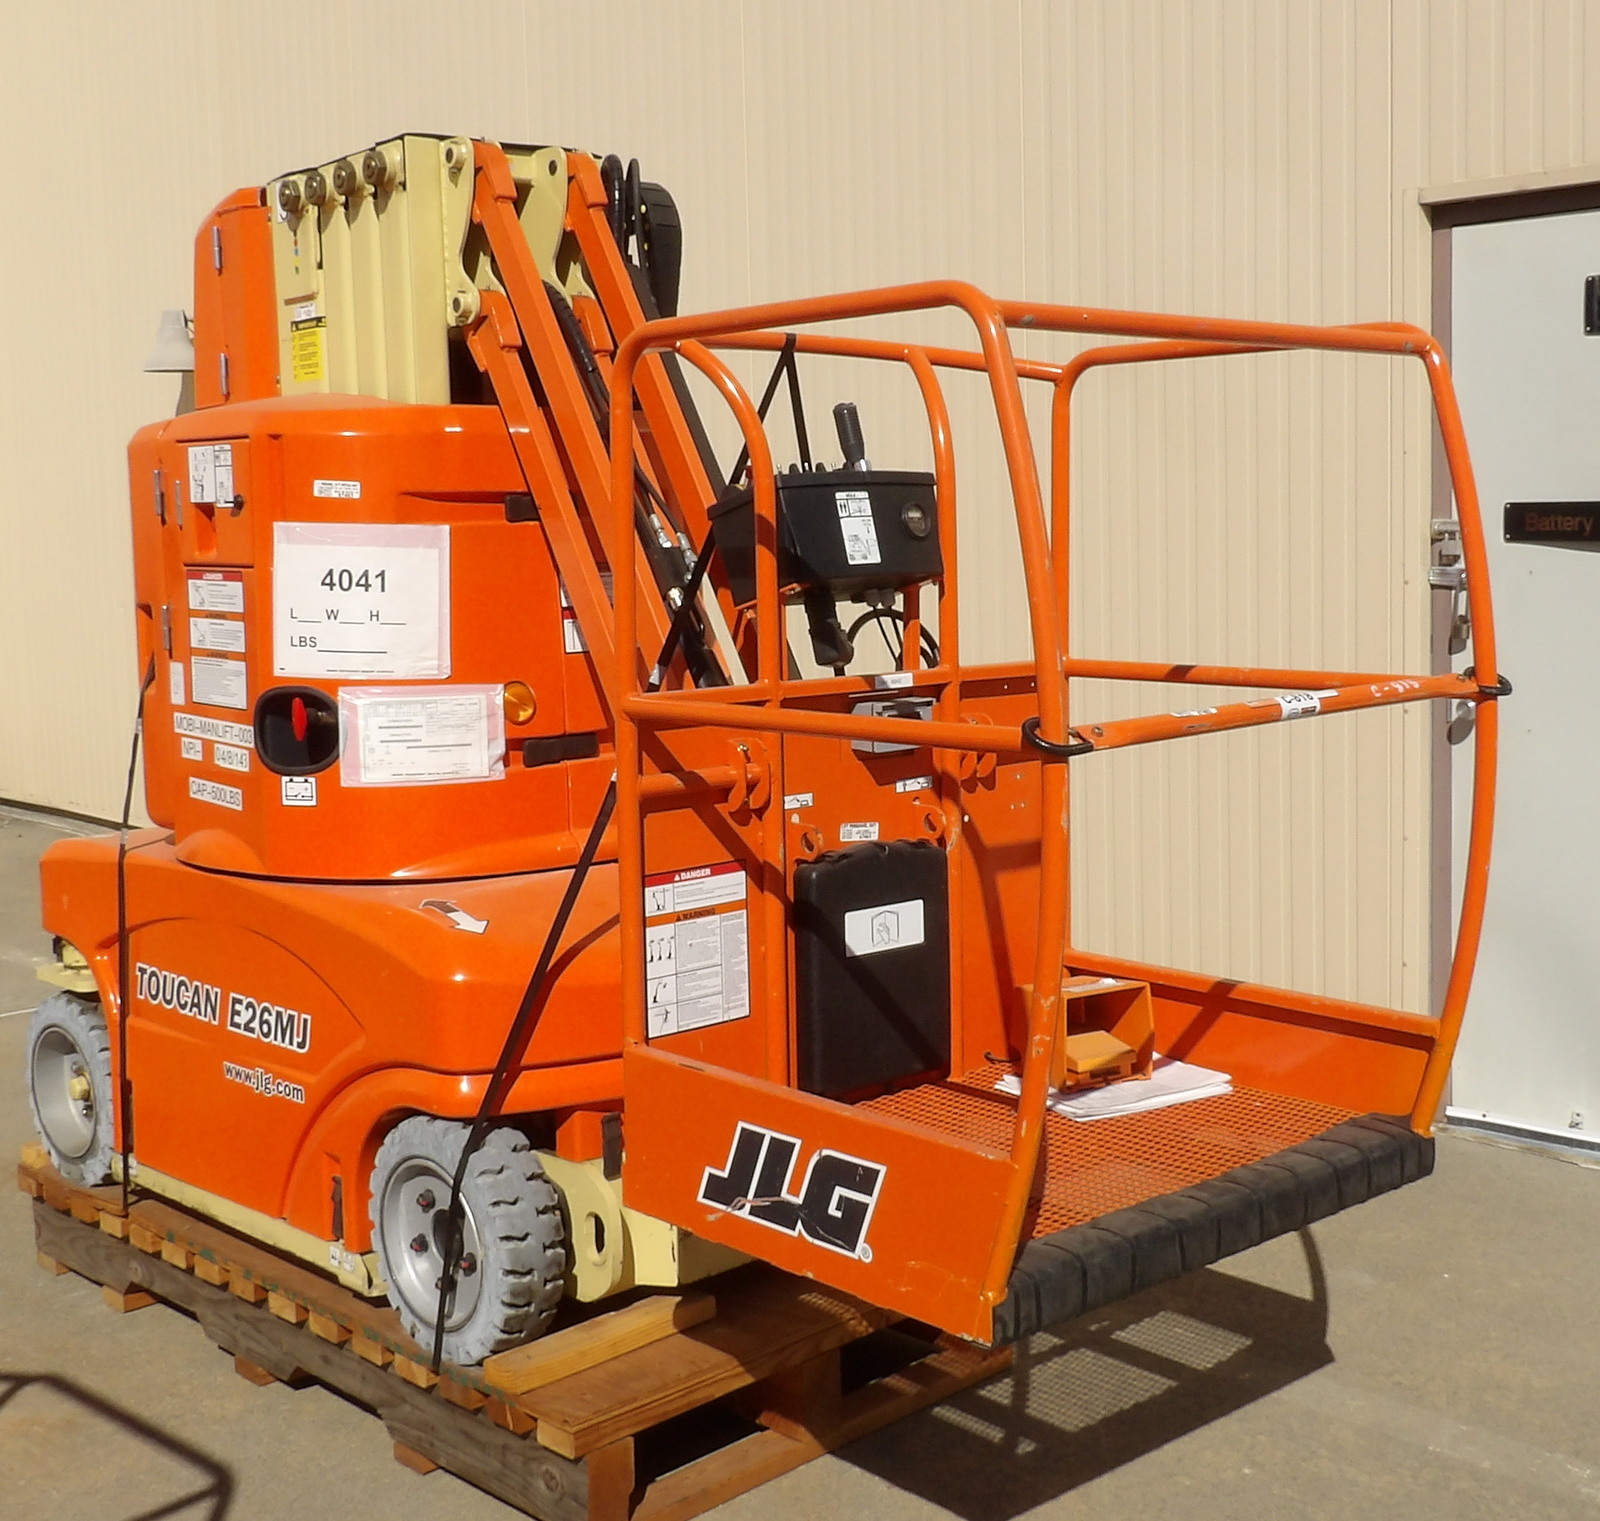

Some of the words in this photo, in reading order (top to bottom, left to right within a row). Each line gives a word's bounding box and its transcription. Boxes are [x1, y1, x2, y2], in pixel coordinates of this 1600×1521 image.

[1525, 512, 1593, 536] Battery
[320, 568, 387, 593] 4041
[681, 868, 711, 880] DANGER
[682, 908, 716, 921] WARNING
[137, 963, 221, 1025] TOUCAN
[227, 992, 311, 1054] E26MJ
[223, 1061, 305, 1104] www.jlg.com
[697, 1120, 868, 1260] JLG
